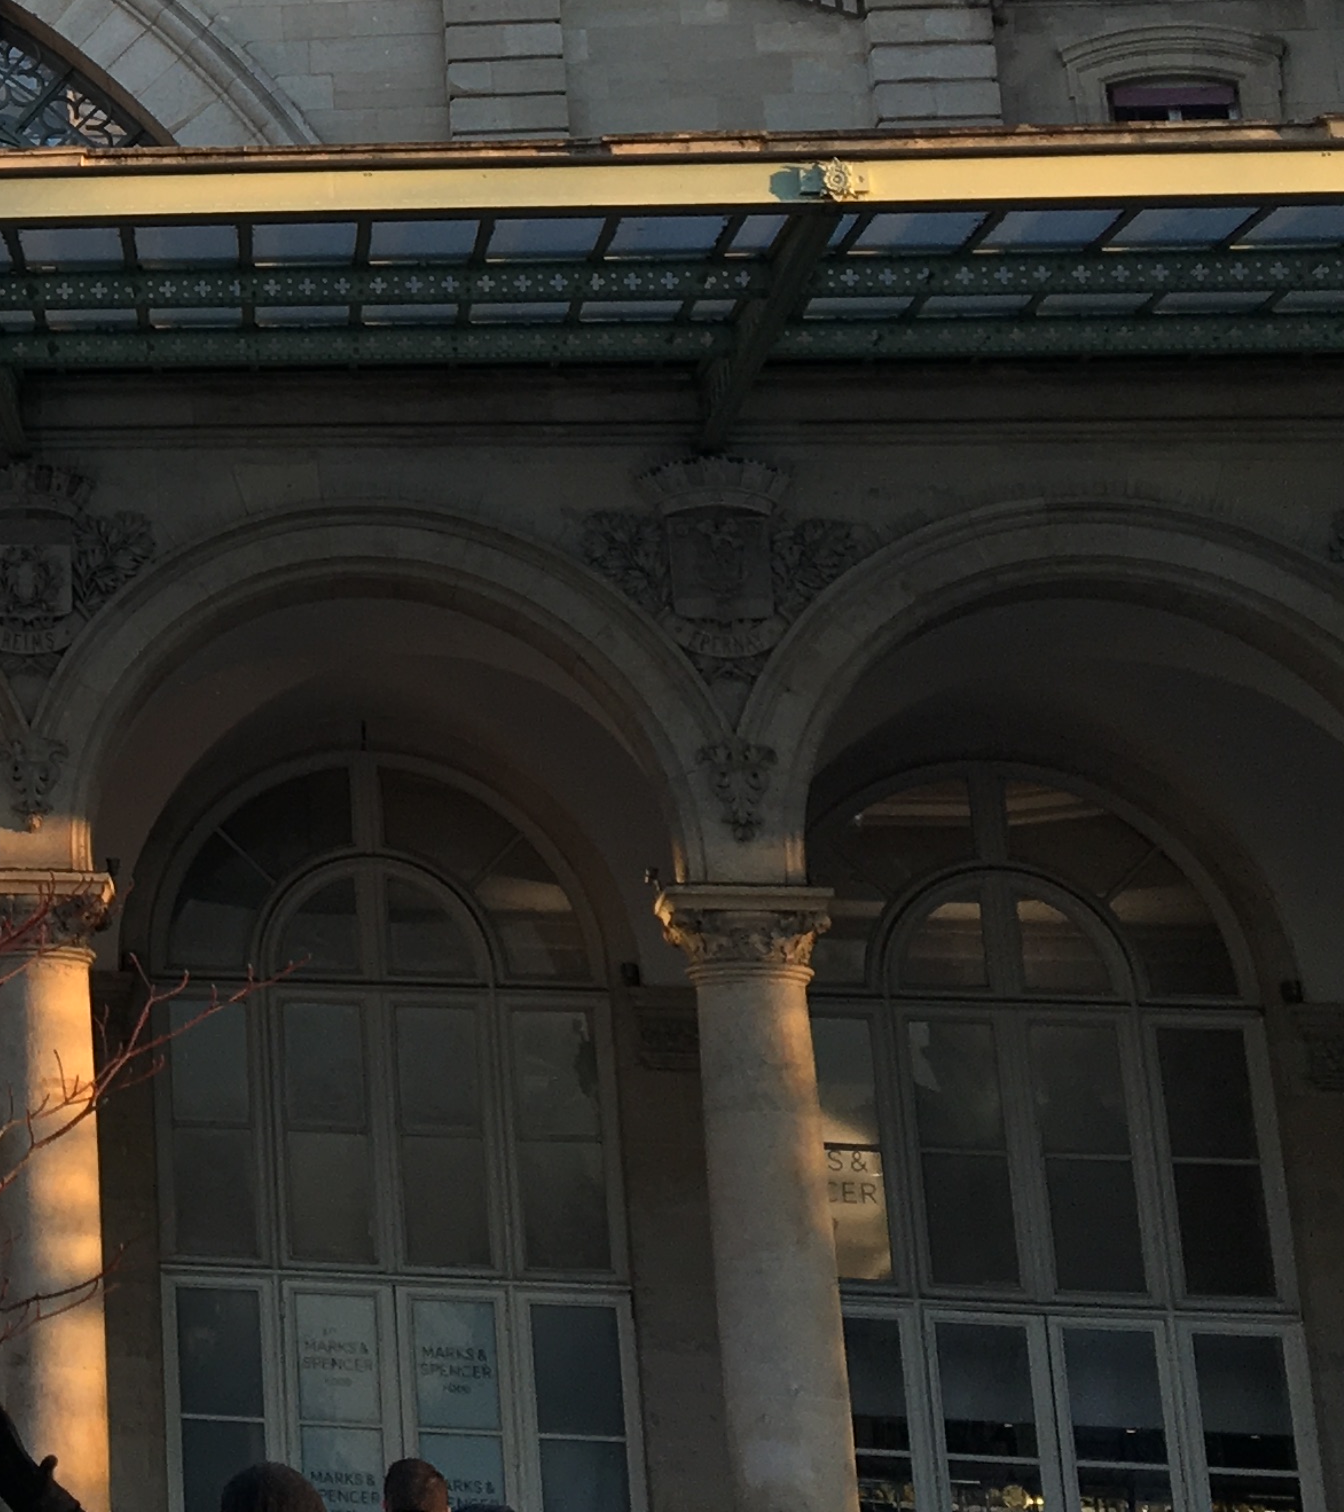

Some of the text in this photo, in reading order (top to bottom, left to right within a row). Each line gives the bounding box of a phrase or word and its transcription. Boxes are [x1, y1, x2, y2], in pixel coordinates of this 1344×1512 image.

[1, 630, 56, 651] REIMS
[305, 1340, 357, 1355] MARKS
[422, 1345, 487, 1362] MARKS &
[303, 1356, 373, 1372] SPENCER
[420, 1363, 492, 1380] SPENCER
[311, 1471, 375, 1487] MARKS &
[486, 1480, 495, 1495] &
[320, 1488, 380, 1504] PENCER
